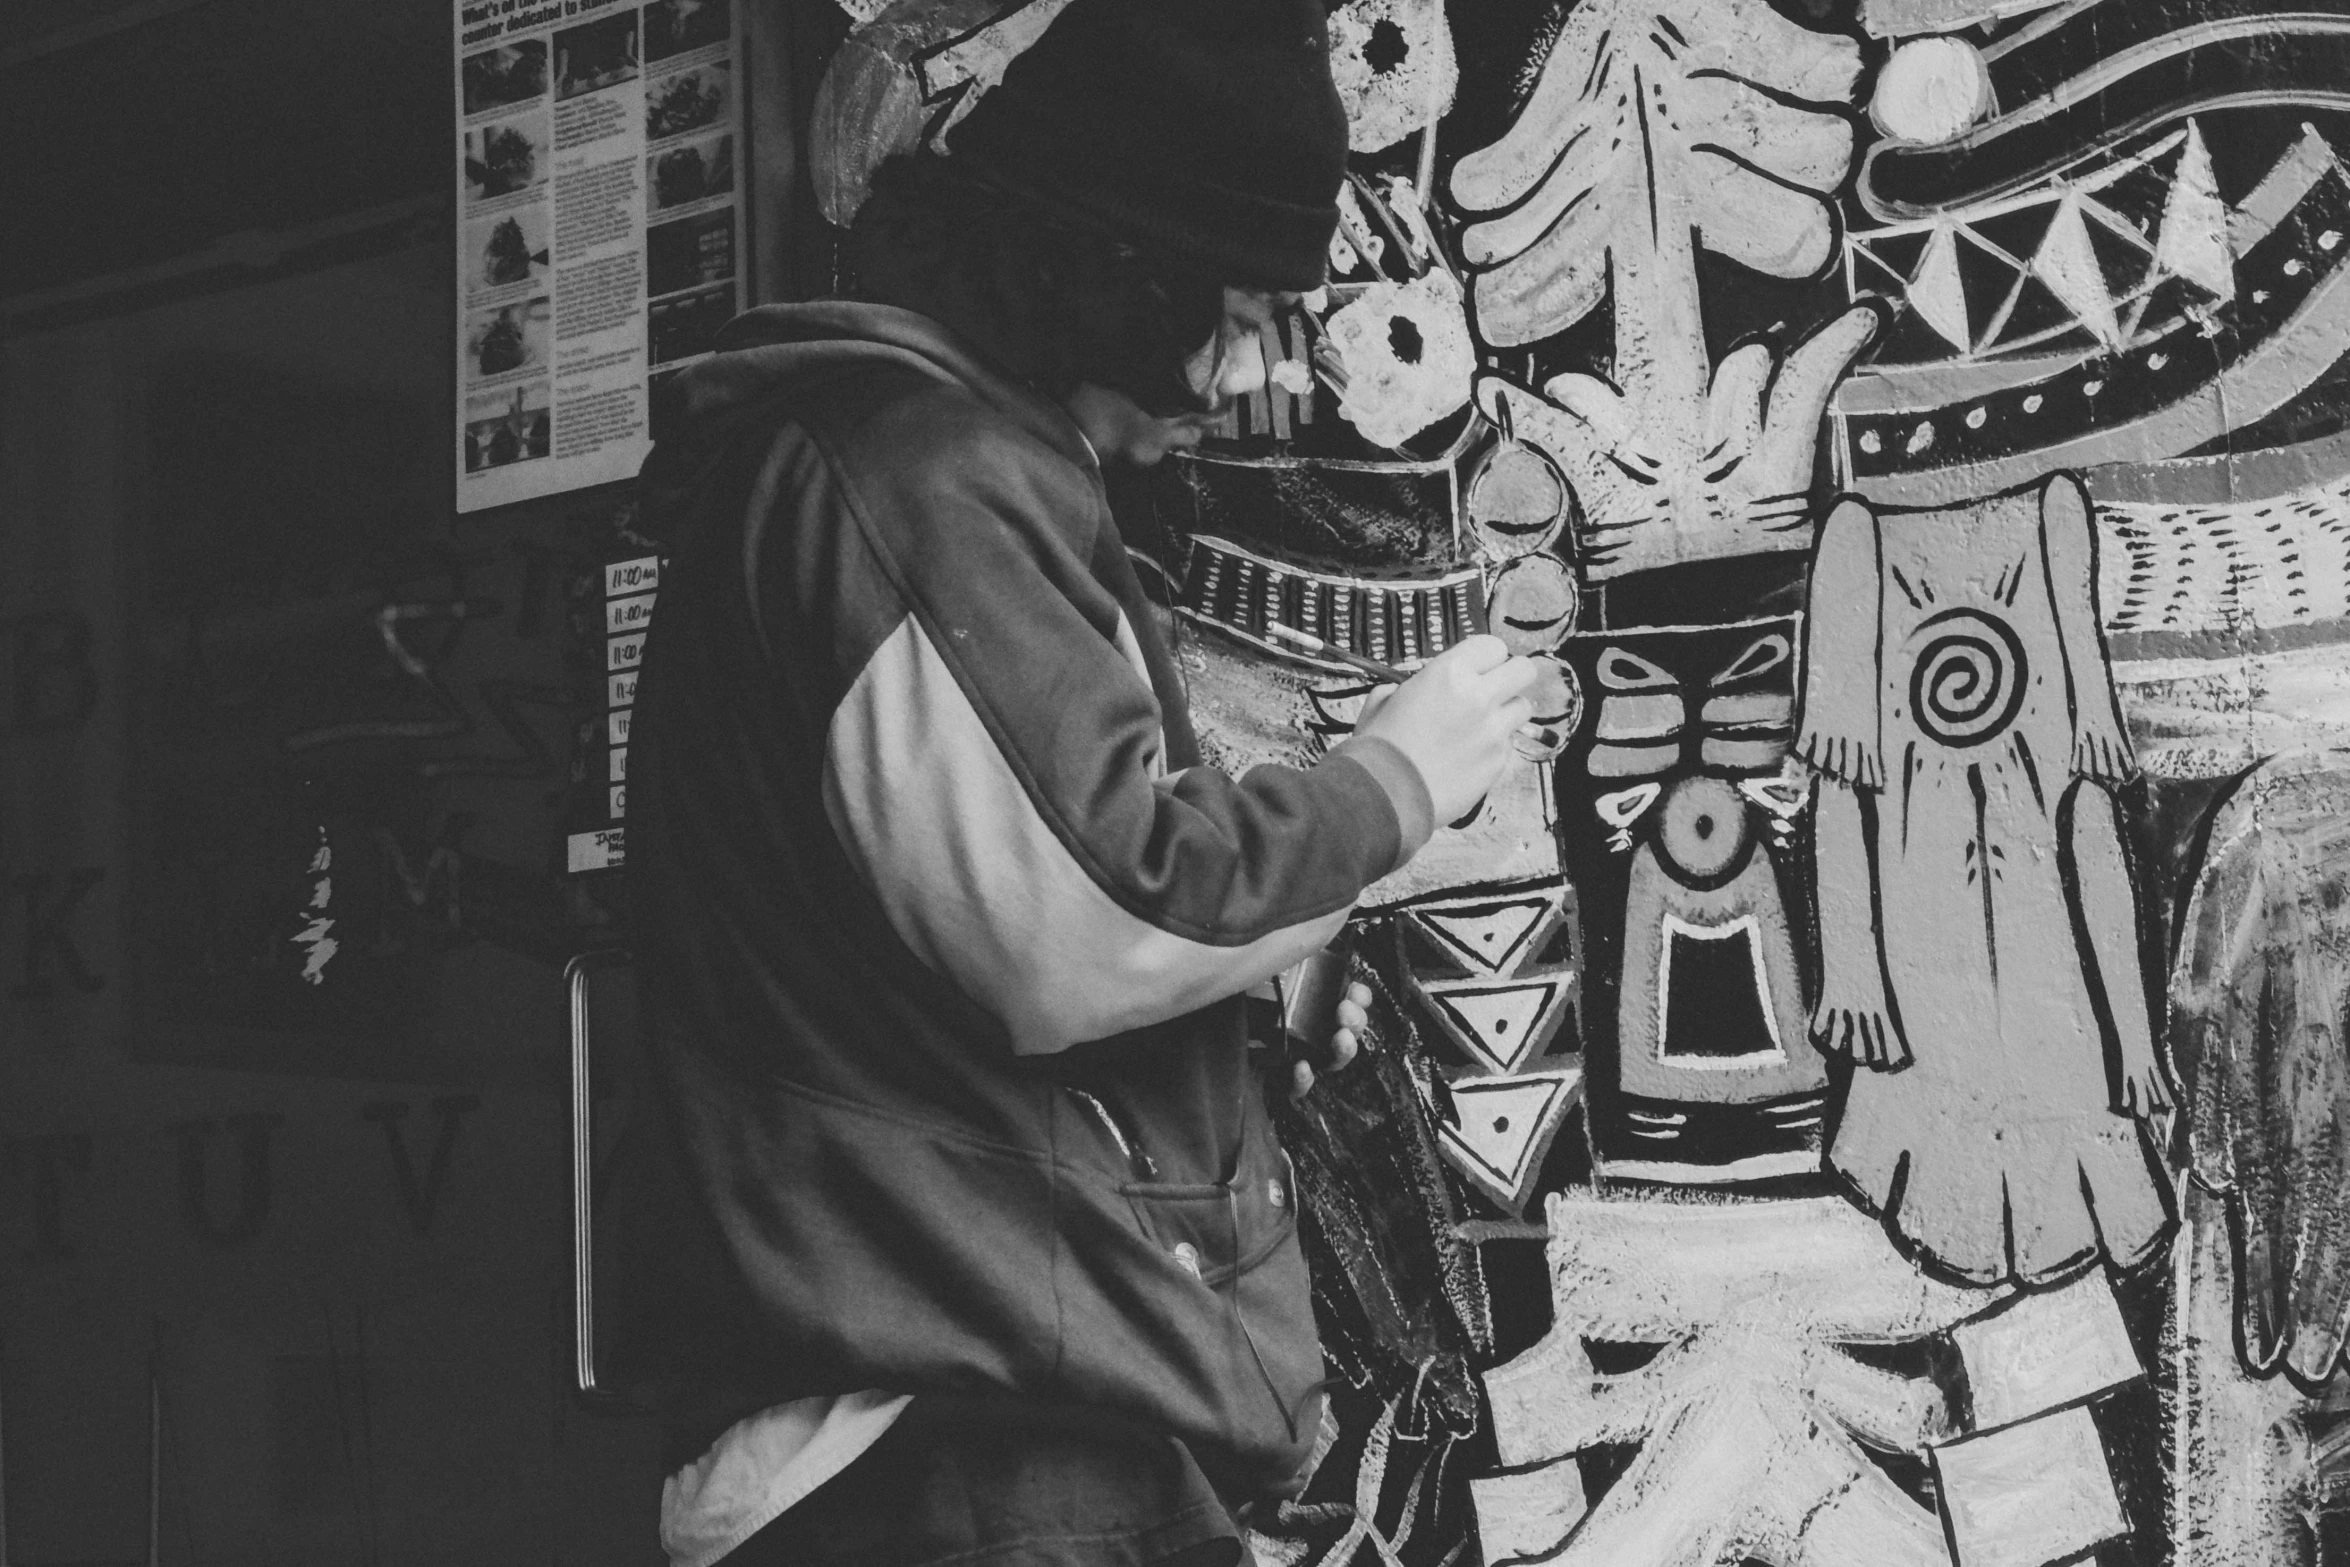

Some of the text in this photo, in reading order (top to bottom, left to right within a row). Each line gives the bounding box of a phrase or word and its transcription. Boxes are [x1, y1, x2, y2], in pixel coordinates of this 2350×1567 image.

[462, 1, 500, 25] What's
[502, 0, 516, 13] on
[462, 22, 504, 45] counter
[507, 1, 562, 32] dedicated
[565, 0, 578, 16] to
[612, 566, 642, 588] 11:00
[615, 604, 641, 625] 11:00
[613, 644, 638, 665] 11:00
[616, 681, 636, 699] 11:0
[362, 1094, 481, 1236] V
